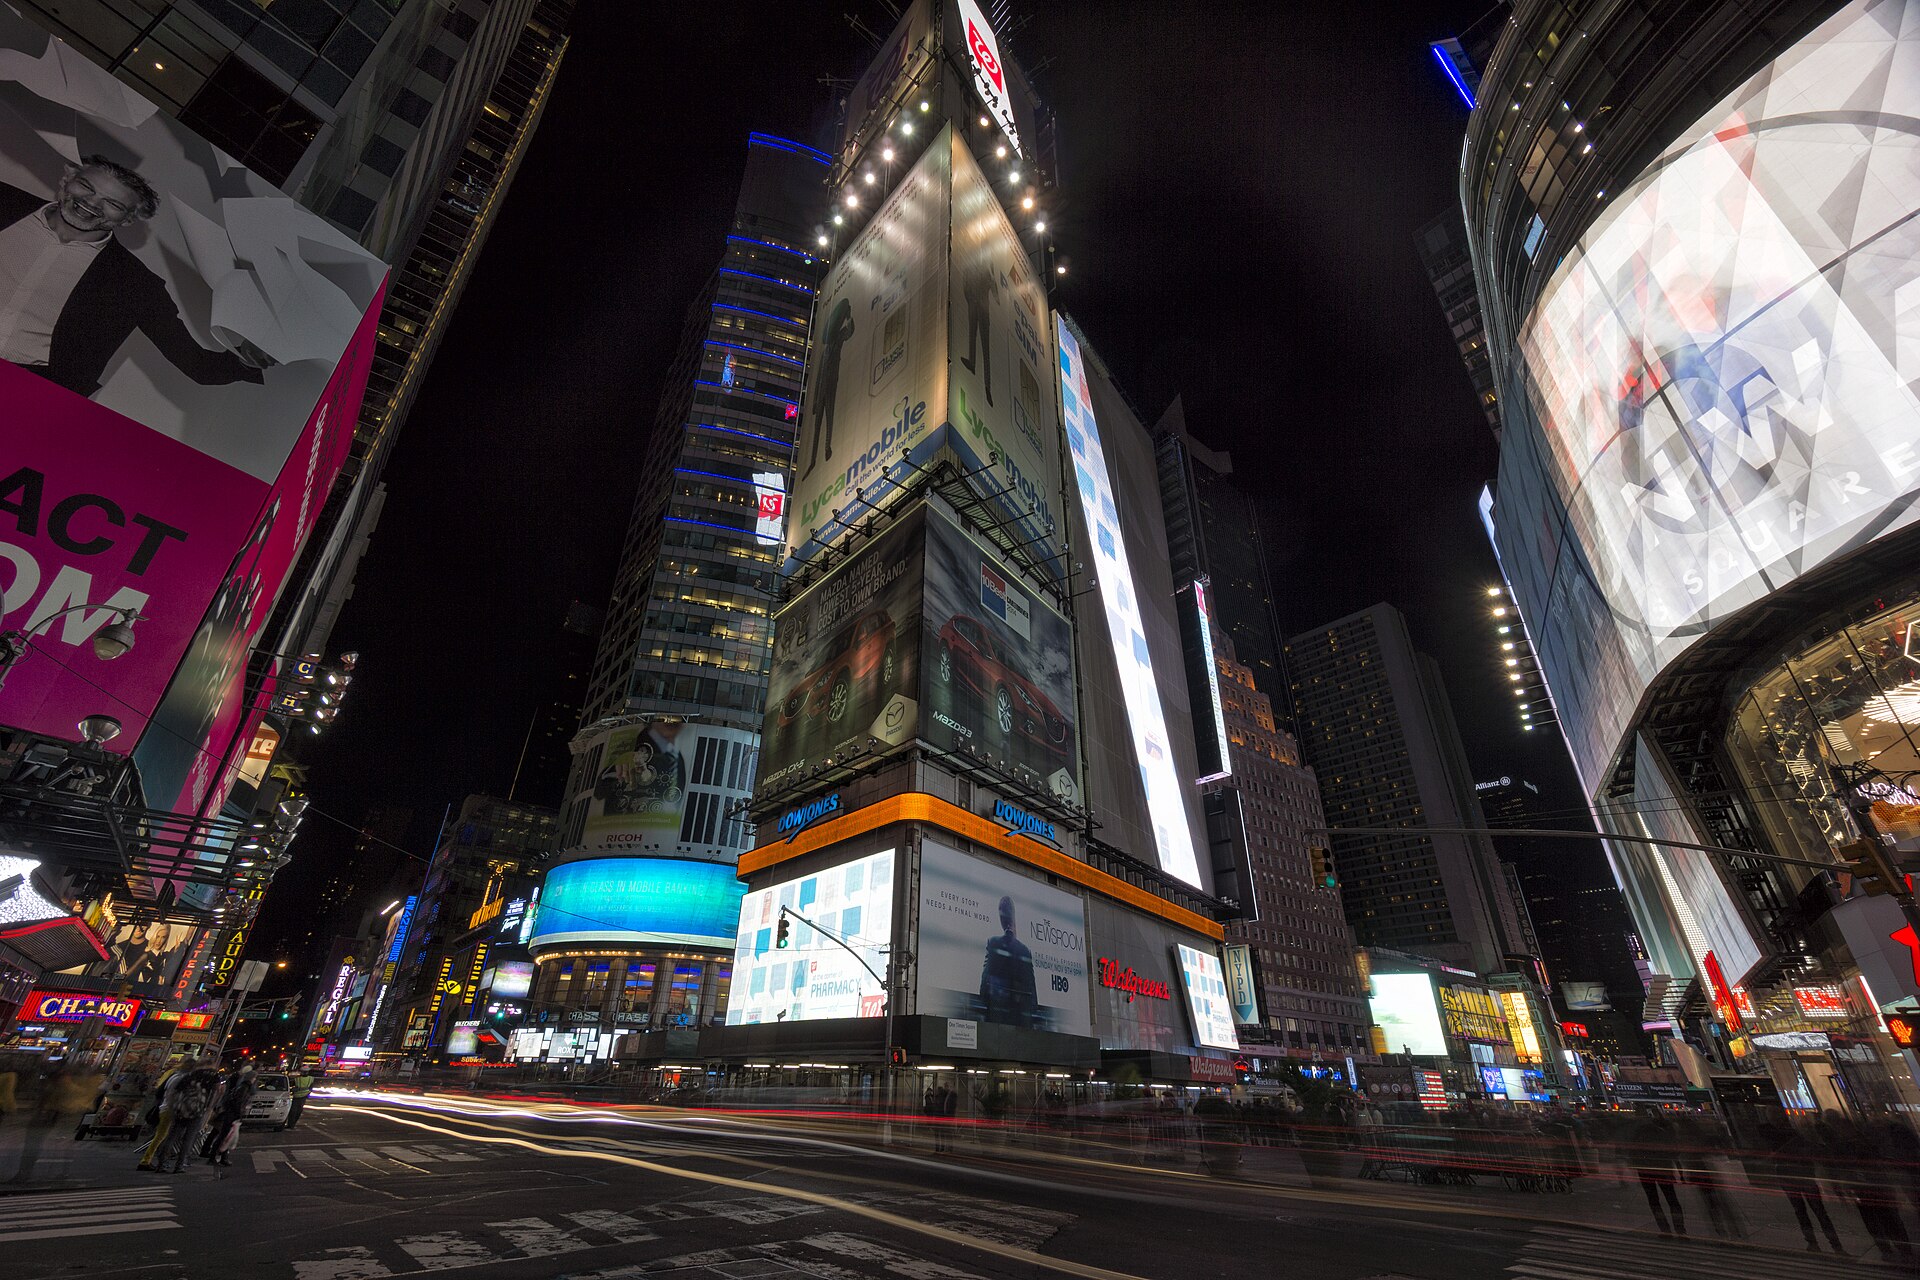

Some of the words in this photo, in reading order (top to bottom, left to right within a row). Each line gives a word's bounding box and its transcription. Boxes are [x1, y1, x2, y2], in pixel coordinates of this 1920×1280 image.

[872, 448, 896, 475] world
[907, 422, 926, 441] less
[820, 574, 847, 602] MAZDA
[849, 550, 880, 582] NAMED
[817, 606, 837, 632] COST
[839, 598, 850, 617] TO
[851, 584, 872, 608] OWN
[819, 586, 850, 618] LOWEST
[1475, 780, 1500, 791] Allianz
[606, 833, 643, 843] RICOH
[628, 880, 662, 893] MOBILE
[925, 899, 947, 911] NEEDS
[954, 906, 973, 919] FINAL
[940, 890, 960, 902] EVERY
[961, 897, 980, 909] STORY
[1030, 920, 1084, 953] NEWSROOM
[463, 985, 477, 1004] NEW
[471, 943, 489, 981] VICTORY
[1051, 973, 1069, 993] HBO
[1099, 956, 1171, 1004] Walgreens
[1233, 950, 1247, 1005] NYPD
[324, 965, 351, 1024] REGAL
[810, 977, 862, 999] PHARMACY
[39, 998, 134, 1022] CHAMPS
[430, 994, 443, 1012] NEW
[1190, 1057, 1234, 1081] Walgreens
[1615, 1083, 1643, 1091] CITIZEN
